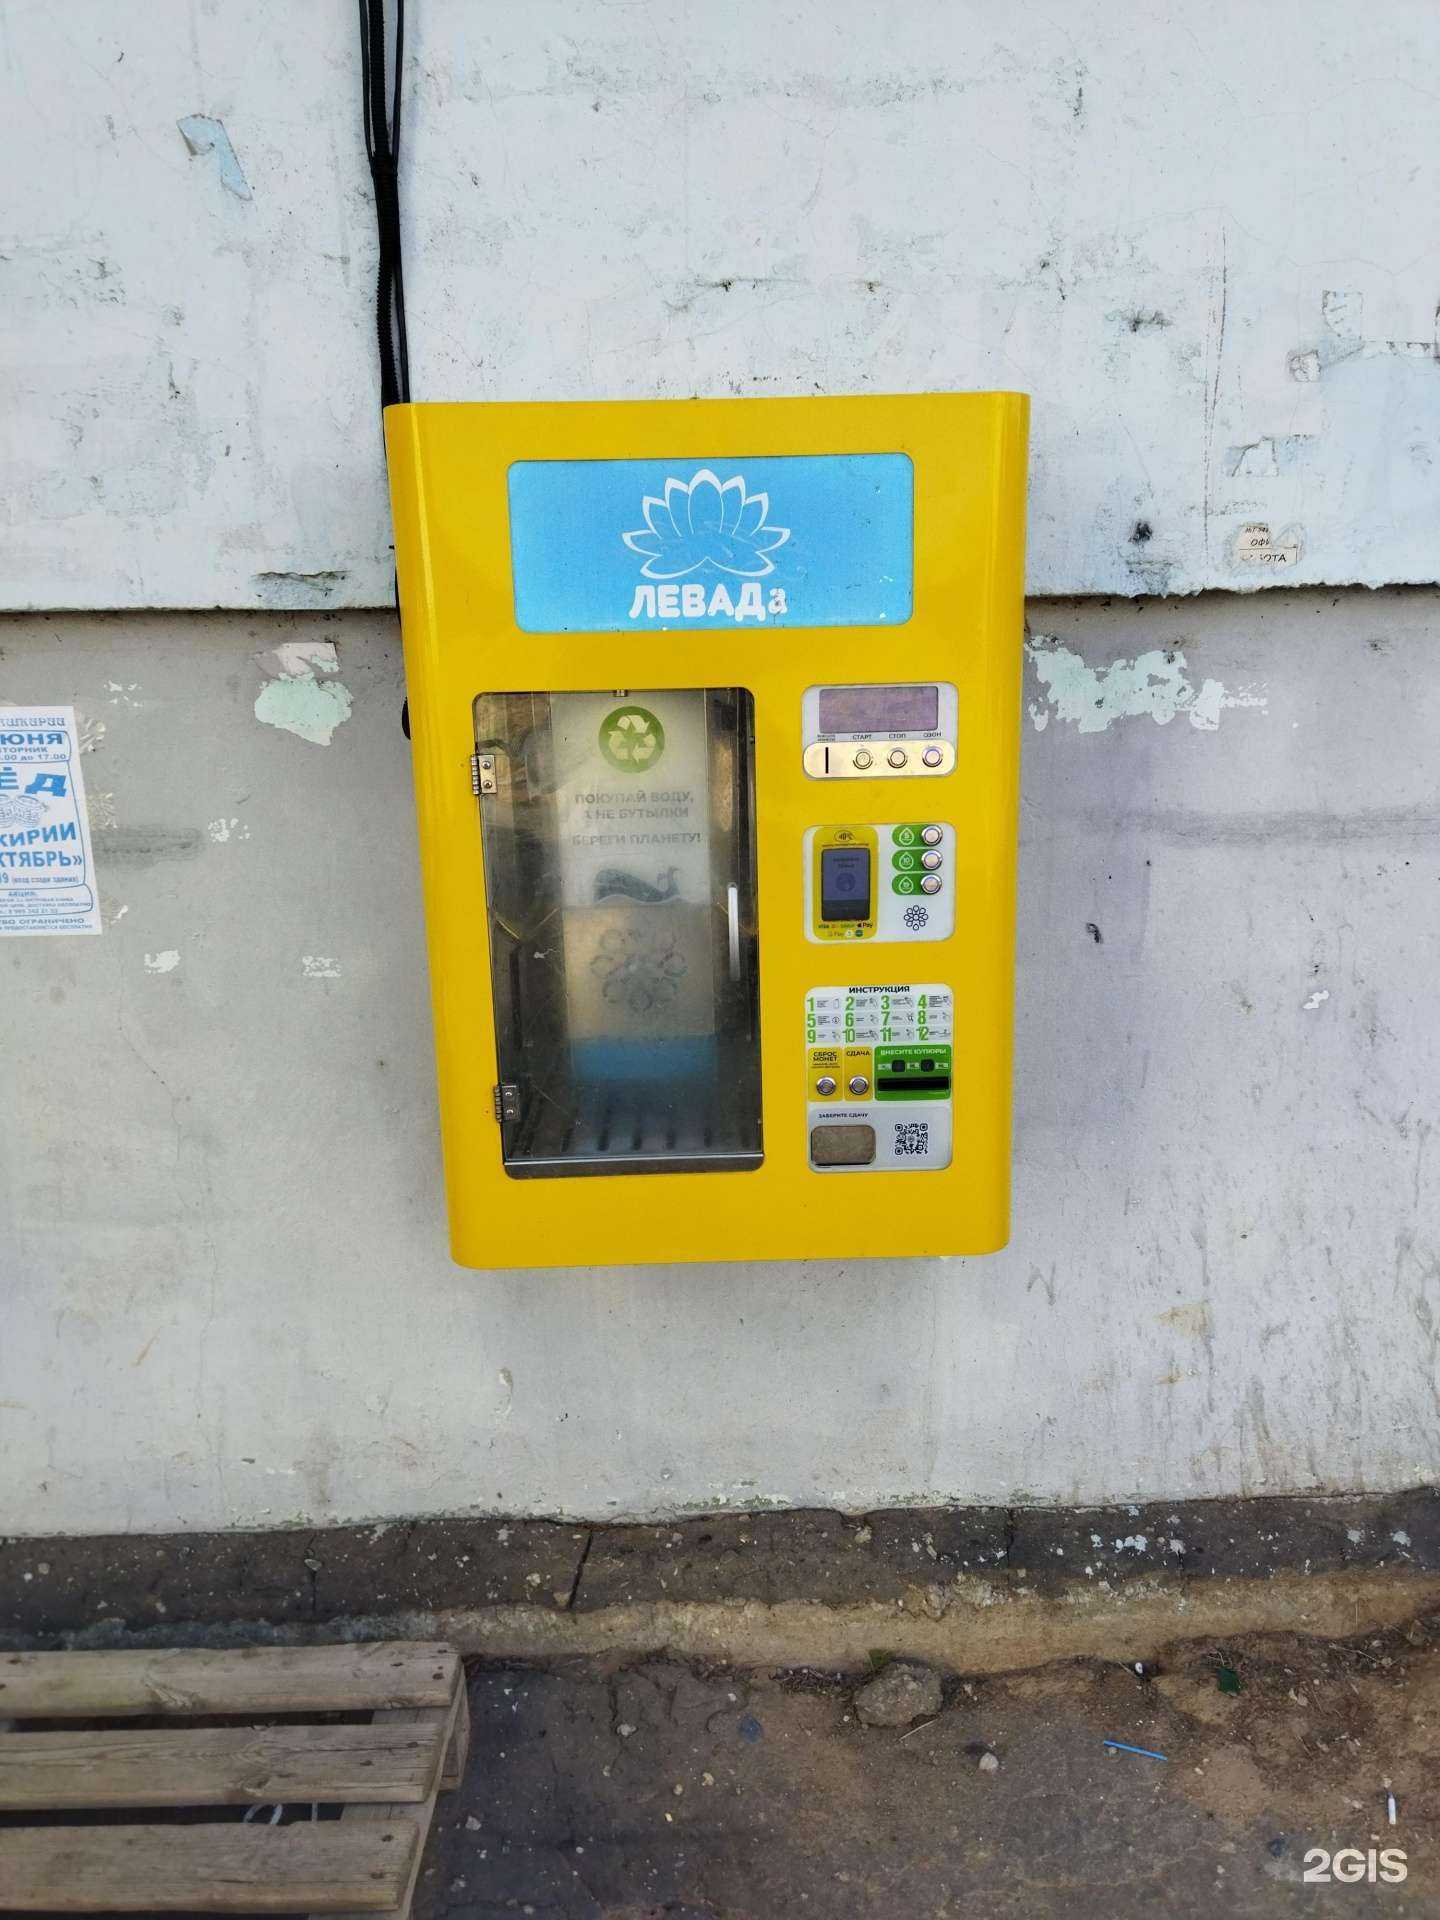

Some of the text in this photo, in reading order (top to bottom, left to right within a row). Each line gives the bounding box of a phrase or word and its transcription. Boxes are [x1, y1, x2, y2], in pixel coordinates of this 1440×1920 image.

[628, 582, 788, 622] ЛЕВАДа
[574, 790, 694, 805] ПОКУПАЙ ВОДУ,
[596, 808, 616, 819] НЕ
[619, 807, 689, 819] БУТЫЛКИ
[572, 832, 702, 846] БЕРЕГИ ПЛАНЕТУ!
[848, 985, 910, 994] ИНСТРУКЦИЯ
[807, 997, 814, 1012] 1
[845, 996, 854, 1011] 2
[881, 995, 890, 1010] 3
[918, 994, 927, 1009] 4
[807, 1013, 816, 1028] 5
[845, 1012, 854, 1027] 6
[881, 1011, 890, 1026] 7
[918, 1010, 926, 1025] 8
[807, 1029, 816, 1043] 9
[843, 1028, 855, 1042] 10
[880, 1027, 891, 1042] 11
[917, 1026, 929, 1040] 12
